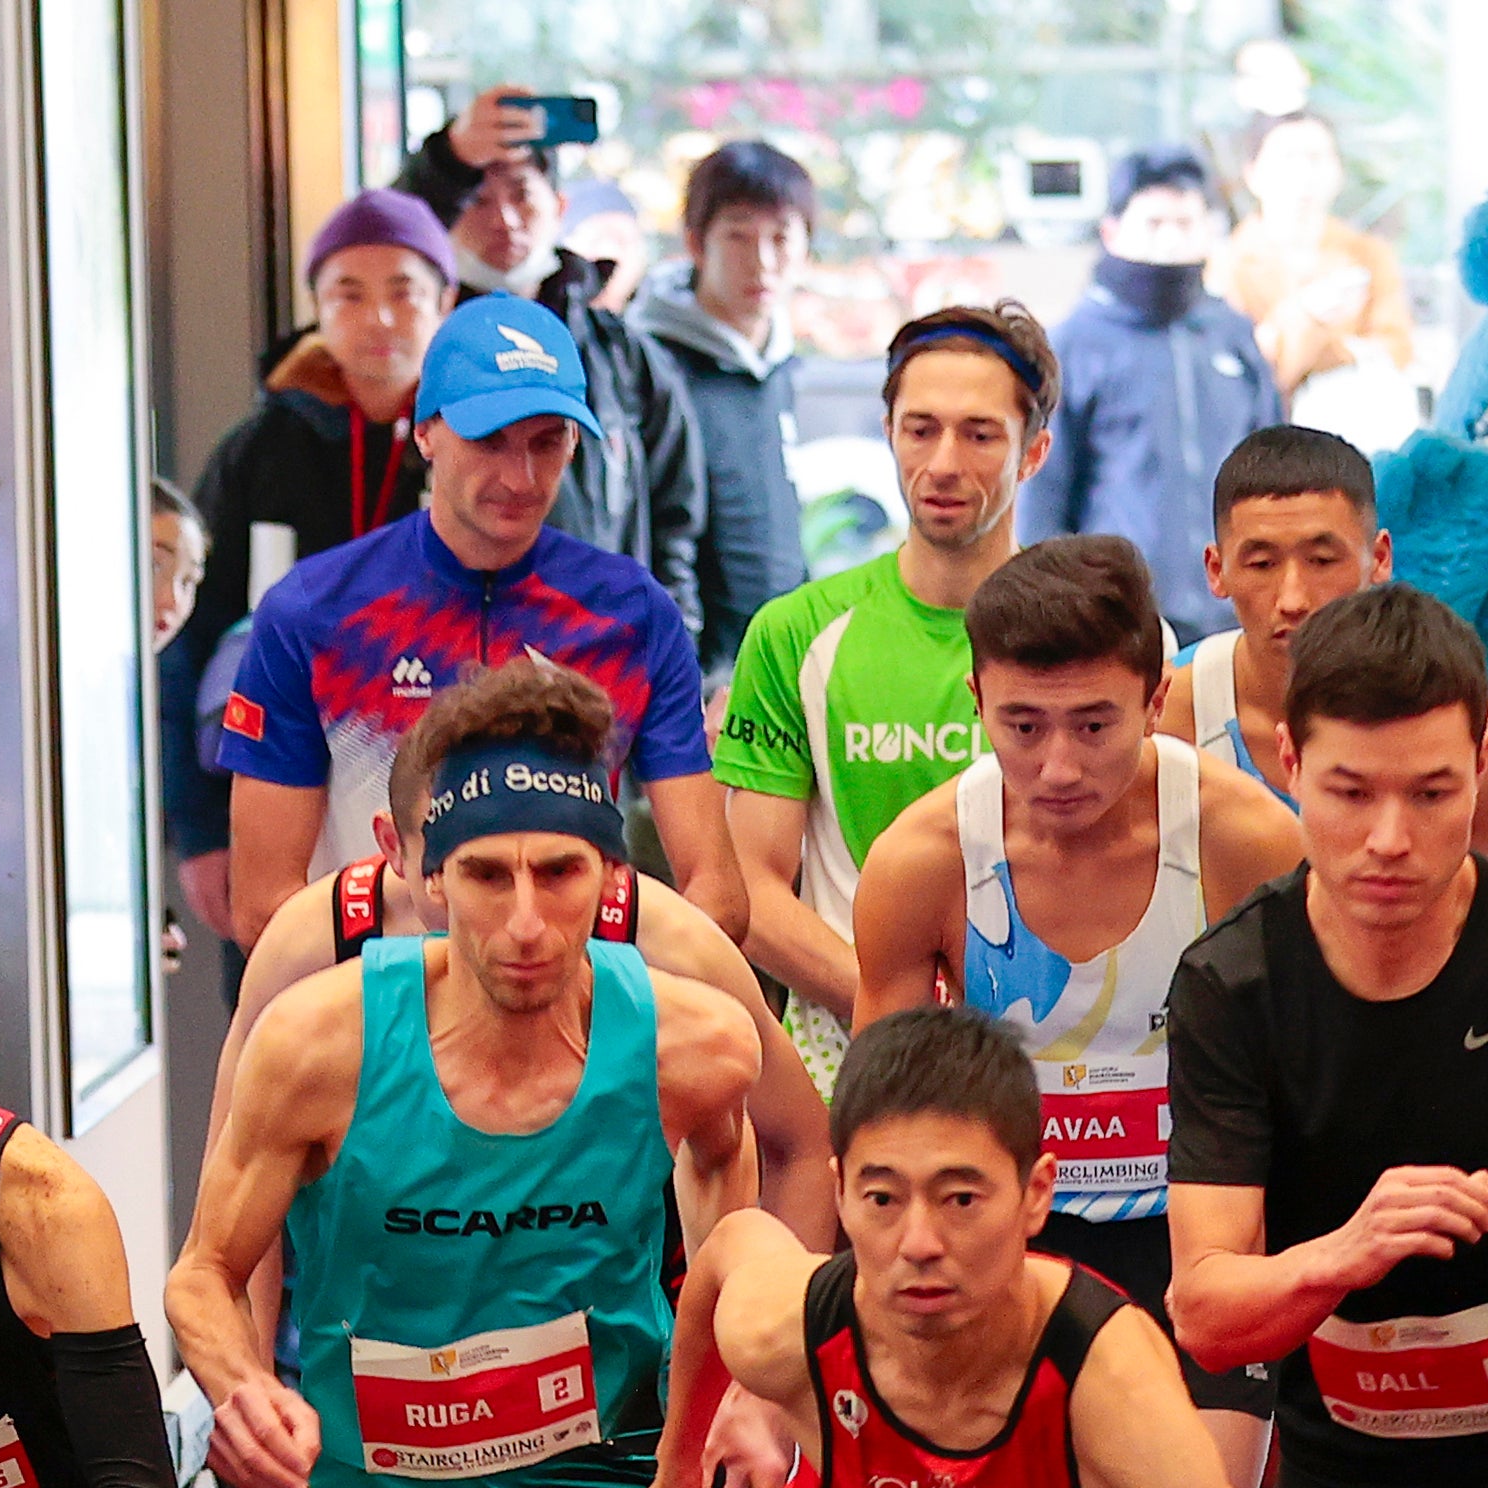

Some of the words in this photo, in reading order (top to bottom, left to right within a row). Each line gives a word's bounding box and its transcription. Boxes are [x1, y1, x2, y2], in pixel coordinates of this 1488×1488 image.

[720, 713, 803, 755] UB.VN
[461, 767, 492, 803] di
[504, 762, 603, 805] Scozia
[346, 863, 375, 919] SJC
[383, 1200, 609, 1239] SCARPA
[404, 1398, 494, 1428] RUGA
[552, 1376, 570, 1402] 2
[1356, 1370, 1439, 1393] BALL
[393, 1434, 546, 1469] STAIRCLIMBING
